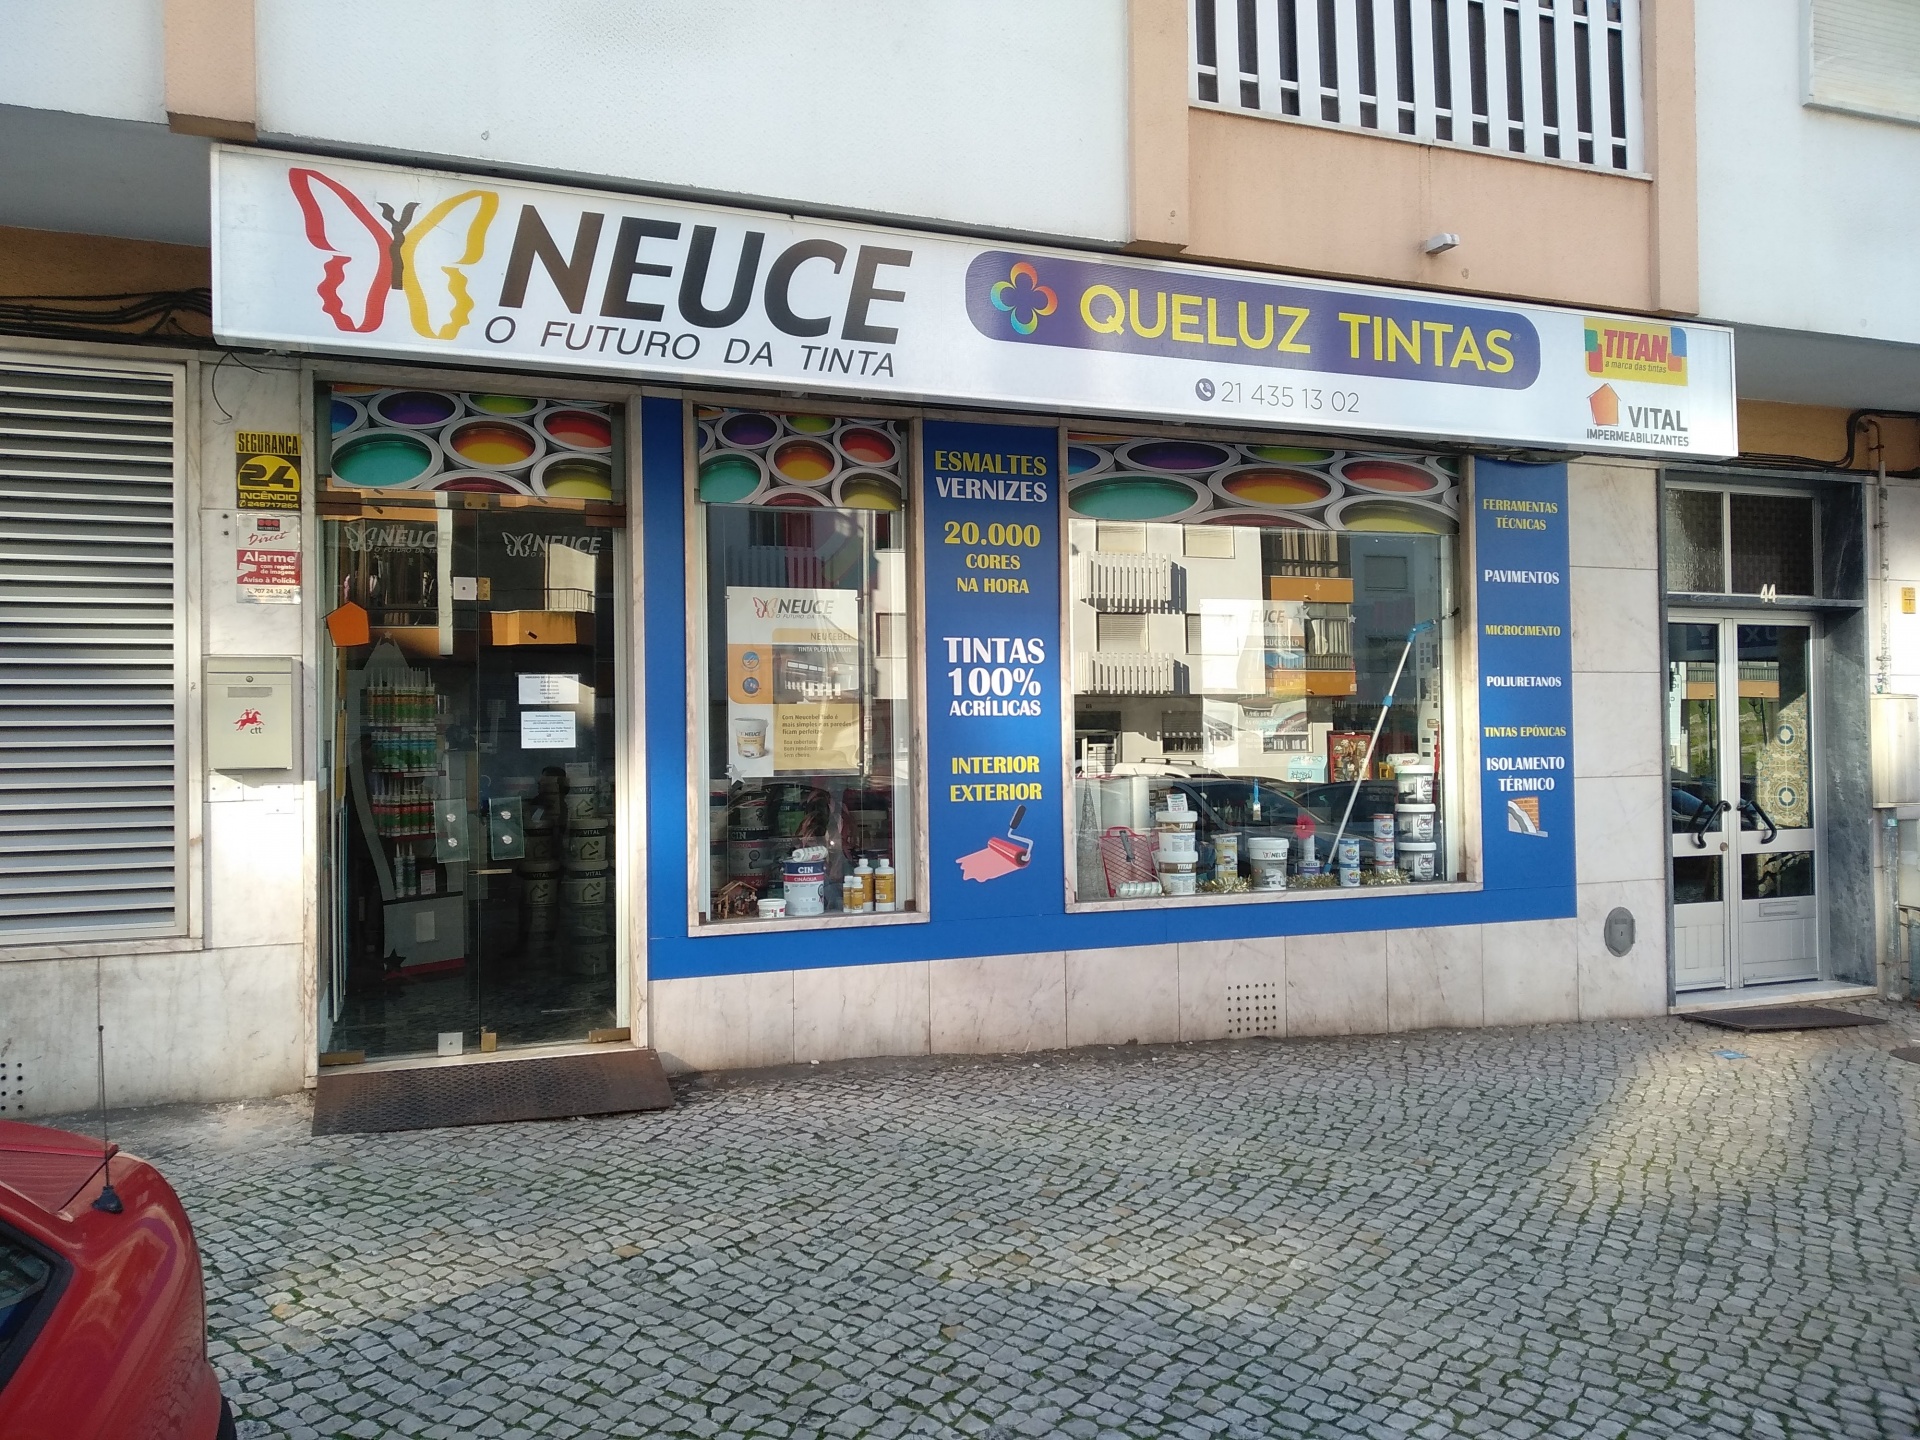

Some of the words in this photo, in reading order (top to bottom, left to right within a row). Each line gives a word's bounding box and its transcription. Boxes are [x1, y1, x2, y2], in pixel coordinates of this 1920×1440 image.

[498, 204, 913, 345] NEUCE
[1079, 283, 1312, 355] QUELUZ
[1338, 311, 1515, 373] TINTAS
[485, 316, 516, 344] O
[540, 321, 701, 361] FUTURO
[723, 338, 774, 368] DA
[800, 345, 895, 378] TINTA
[1604, 329, 1669, 363] TITAN
[1611, 361, 1632, 369] marca
[1635, 362, 1647, 371] das
[1648, 363, 1667, 373] tintas
[1221, 381, 1241, 402] 21
[1248, 383, 1293, 408] 435
[1301, 388, 1323, 411] 13
[1330, 390, 1360, 414] 02
[1628, 406, 1688, 431] VITAL
[1586, 428, 1690, 447] IMPERMEABILIZANTES
[934, 449, 1048, 477] ESMALTES
[240, 463, 294, 488] 24
[240, 491, 298, 501] INCÊNDIO
[935, 476, 1048, 503] VERNIZES
[1483, 498, 1559, 515] FERRAMENTAS
[1495, 515, 1547, 531] TÉCNICAS
[248, 531, 290, 545] Direct
[376, 528, 452, 549] NEUCE
[944, 520, 1041, 549] 20.000
[243, 551, 296, 563] Alarme
[965, 552, 1021, 571] CORES
[957, 576, 979, 592] NA
[984, 577, 1030, 594] HORA
[1484, 569, 1560, 585] PAVIMENTOS
[1760, 583, 1777, 603] 44
[778, 599, 834, 615] NEUCE
[1249, 609, 1285, 624] EUCE
[810, 632, 852, 641] NEUCEBEL
[1485, 624, 1561, 637] MICROCIMENTO
[943, 636, 1046, 665] TINTAS
[947, 666, 1042, 698] 100%
[1486, 676, 1562, 688] POLIURETANOS
[949, 695, 1042, 717] ACRÍLICAS
[796, 721, 818, 729] simples
[830, 722, 852, 730] paredes
[1483, 726, 1518, 738] TINTAS
[1520, 724, 1567, 738] EPÓXICAS
[951, 755, 1041, 775] INTERIOR
[1486, 756, 1565, 771] ISOLAMENTO
[950, 782, 1043, 802] EXTERIOR
[1498, 774, 1555, 792] TÉRMICO
[731, 831, 746, 840] CIN
[798, 866, 814, 874] CIN
